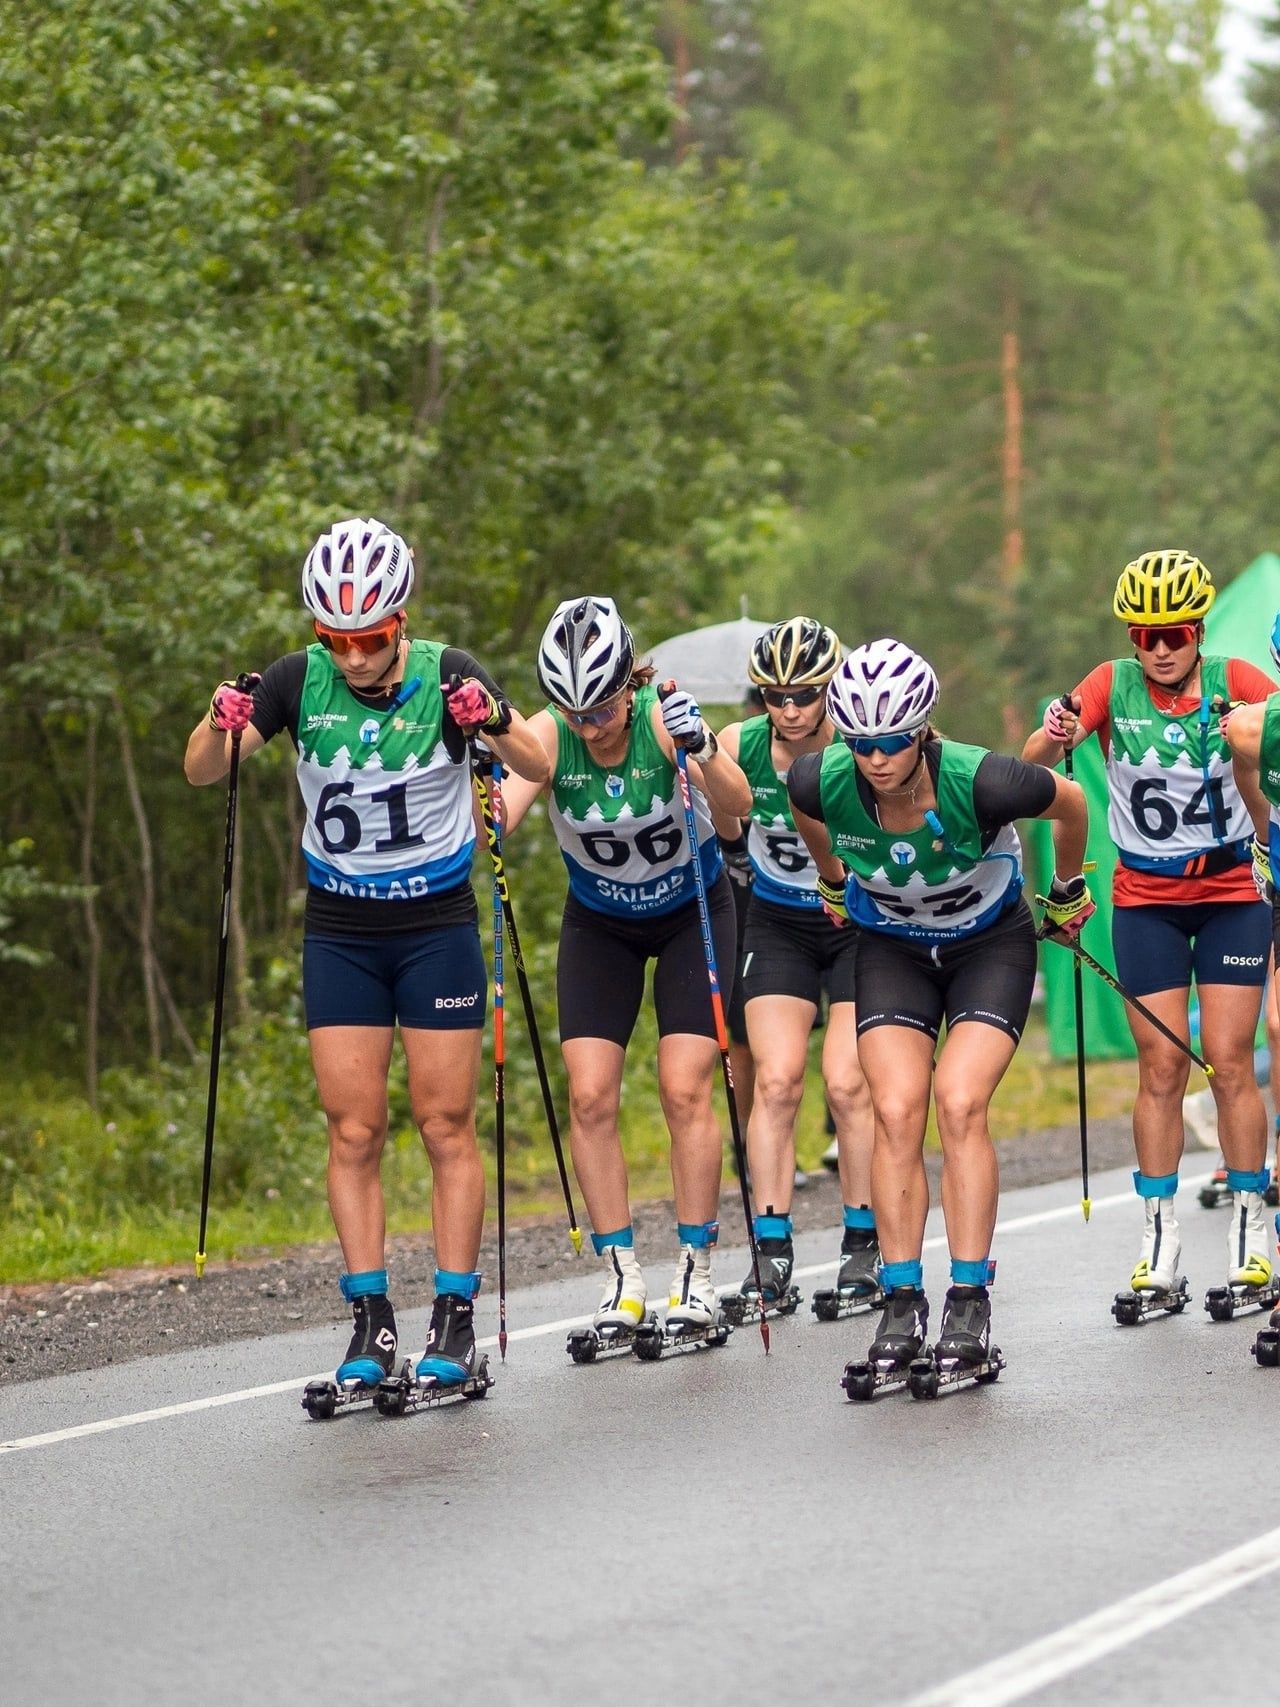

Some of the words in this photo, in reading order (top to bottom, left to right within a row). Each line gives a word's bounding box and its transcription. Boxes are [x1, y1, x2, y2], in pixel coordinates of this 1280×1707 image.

[1129, 776, 1232, 840] 64
[314, 781, 426, 855] 61
[576, 814, 683, 867] 66
[837, 833, 876, 845] АКАДЕМИЯ
[596, 872, 685, 903] SKILAB
[800, 895, 816, 903] SKI
[631, 904, 647, 912] SKI
[1223, 955, 1259, 966] BOSCO
[435, 996, 475, 1009] BOSCO
